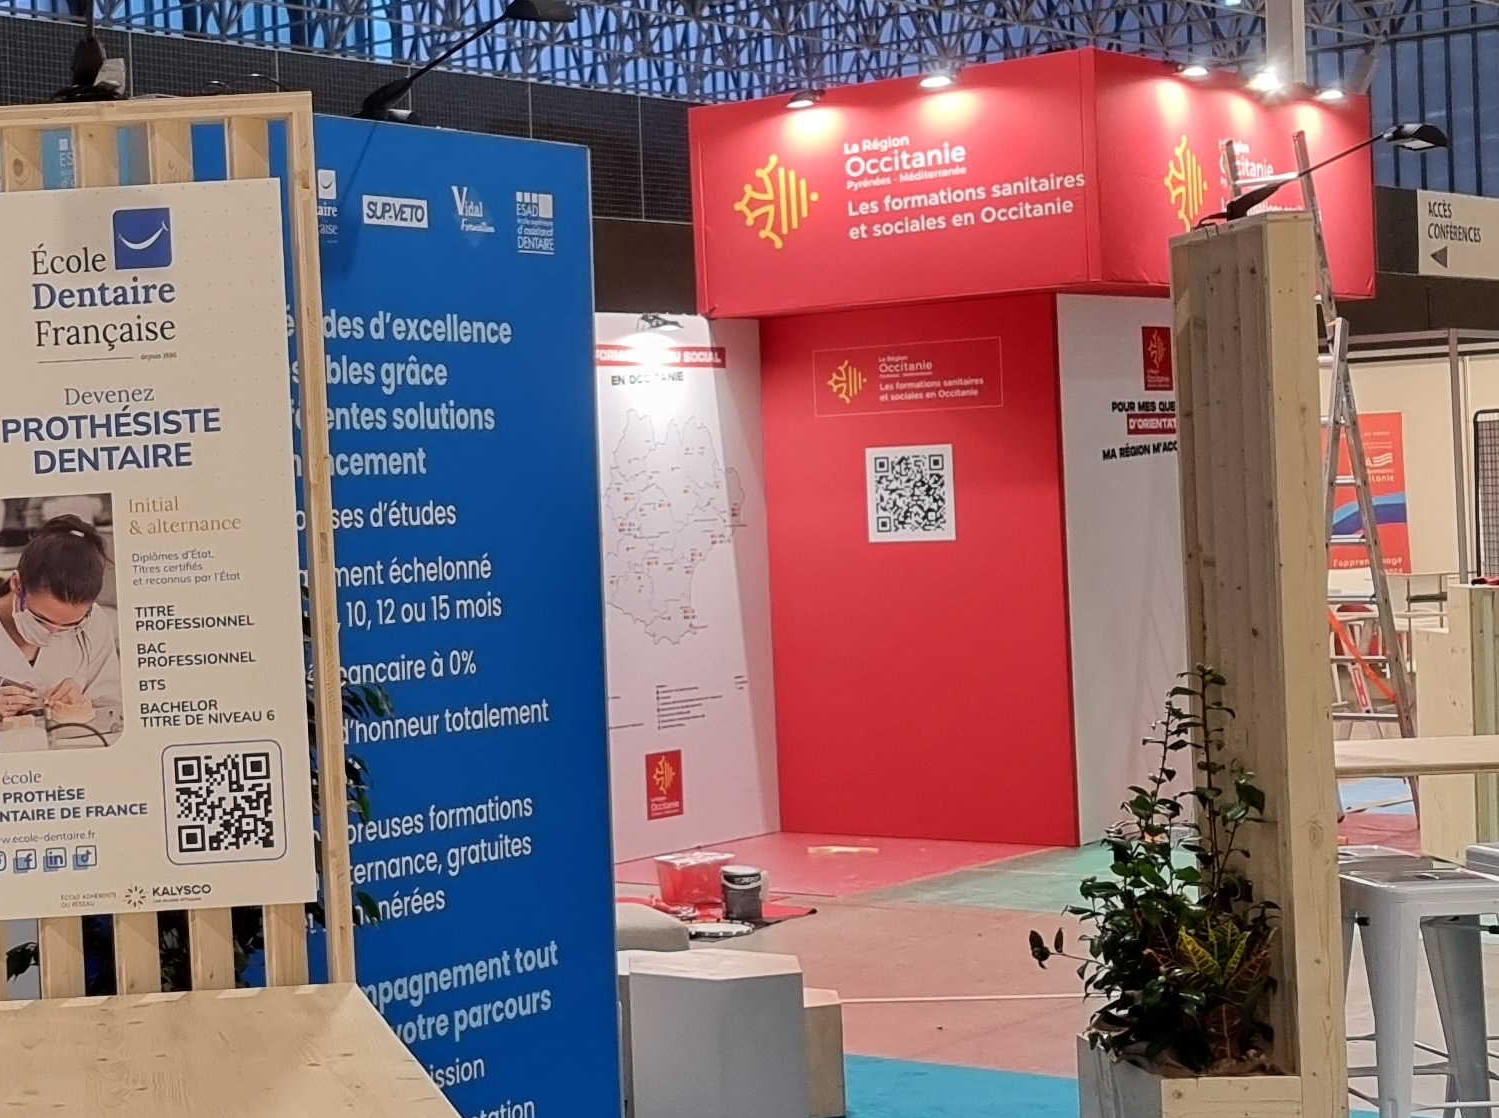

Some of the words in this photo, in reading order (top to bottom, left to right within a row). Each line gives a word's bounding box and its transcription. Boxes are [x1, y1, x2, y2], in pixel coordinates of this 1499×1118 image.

[844, 140, 860, 155] La
[863, 134, 909, 153] Région
[845, 142, 966, 178] Occitanie
[847, 176, 891, 191] Pyrénées
[899, 166, 966, 183] Méditerranée
[451, 186, 483, 218] Vidal
[848, 199, 879, 217] Les
[884, 186, 986, 213] formations
[991, 173, 1085, 199] sanitaires
[366, 201, 425, 222] SUP-VETO
[516, 204, 538, 217] ESAD
[849, 222, 868, 240] et
[873, 213, 946, 238] sociales
[952, 213, 975, 227] en
[981, 198, 1074, 224] Occitanie
[1428, 200, 1453, 219] ACCÈS
[1428, 220, 1481, 244] CONFÉRENCES
[518, 237, 554, 250] DENTAIRE
[32, 244, 106, 275] École
[32, 276, 175, 309] Dentaire
[35, 315, 176, 351] Française
[370, 311, 512, 344] d'excellence
[684, 351, 721, 363] SOCIAL
[879, 360, 933, 373] Occitanie
[380, 355, 448, 395] grâce
[611, 374, 625, 386] EN
[880, 382, 894, 391] Les
[896, 380, 941, 390] formations
[943, 377, 983, 387] sanitaires
[64, 386, 155, 406] Devenez
[880, 393, 888, 401] et
[891, 391, 923, 400] sociales
[938, 388, 978, 398] Occitanie
[392, 400, 496, 430] solutions
[1112, 401, 1135, 412] POUR
[1138, 401, 1156, 411] MES
[2, 405, 220, 443] PROTHÉSISTE
[34, 443, 192, 474] DENTAIRE
[1103, 449, 1117, 461] MA
[1120, 444, 1150, 458] RÉGION
[129, 496, 179, 513] Initial
[370, 500, 457, 528] d'études
[129, 520, 142, 534] &
[148, 518, 241, 533] alternance
[132, 551, 179, 562] Diplômes
[133, 564, 161, 573] Titres
[164, 562, 203, 572] certifiés
[389, 553, 492, 584] échelonné
[133, 577, 142, 585] et
[145, 575, 191, 585] reconnus
[195, 574, 211, 585] par
[214, 571, 241, 581] l'État
[135, 605, 175, 617] TITRE
[346, 601, 372, 630] 10,
[376, 599, 396, 625] 12
[401, 600, 426, 622] ou
[431, 595, 450, 620] 15
[456, 591, 502, 619] mois
[136, 615, 254, 631] PROFESSIONNEL
[137, 643, 167, 654] BAC
[138, 652, 256, 668] PROFESSIONNEL
[432, 652, 444, 678] à
[450, 650, 477, 676] 0%
[139, 679, 166, 691] BTS
[140, 700, 218, 714] BACHELOR
[445, 700, 549, 733] totalement
[141, 715, 181, 727] TITRE
[185, 714, 204, 725] DE
[208, 711, 262, 724] NIVEAU
[267, 710, 275, 721] 6
[2, 770, 42, 785] école
[2, 786, 85, 804] PROTHÈSE
[60, 807, 81, 819] DE
[86, 803, 148, 818] FRANCE
[429, 795, 533, 832] formations
[448, 834, 532, 877] gratuites
[152, 884, 212, 897] KALYSCO
[515, 940, 558, 974] tout
[454, 987, 551, 1042] parcours
